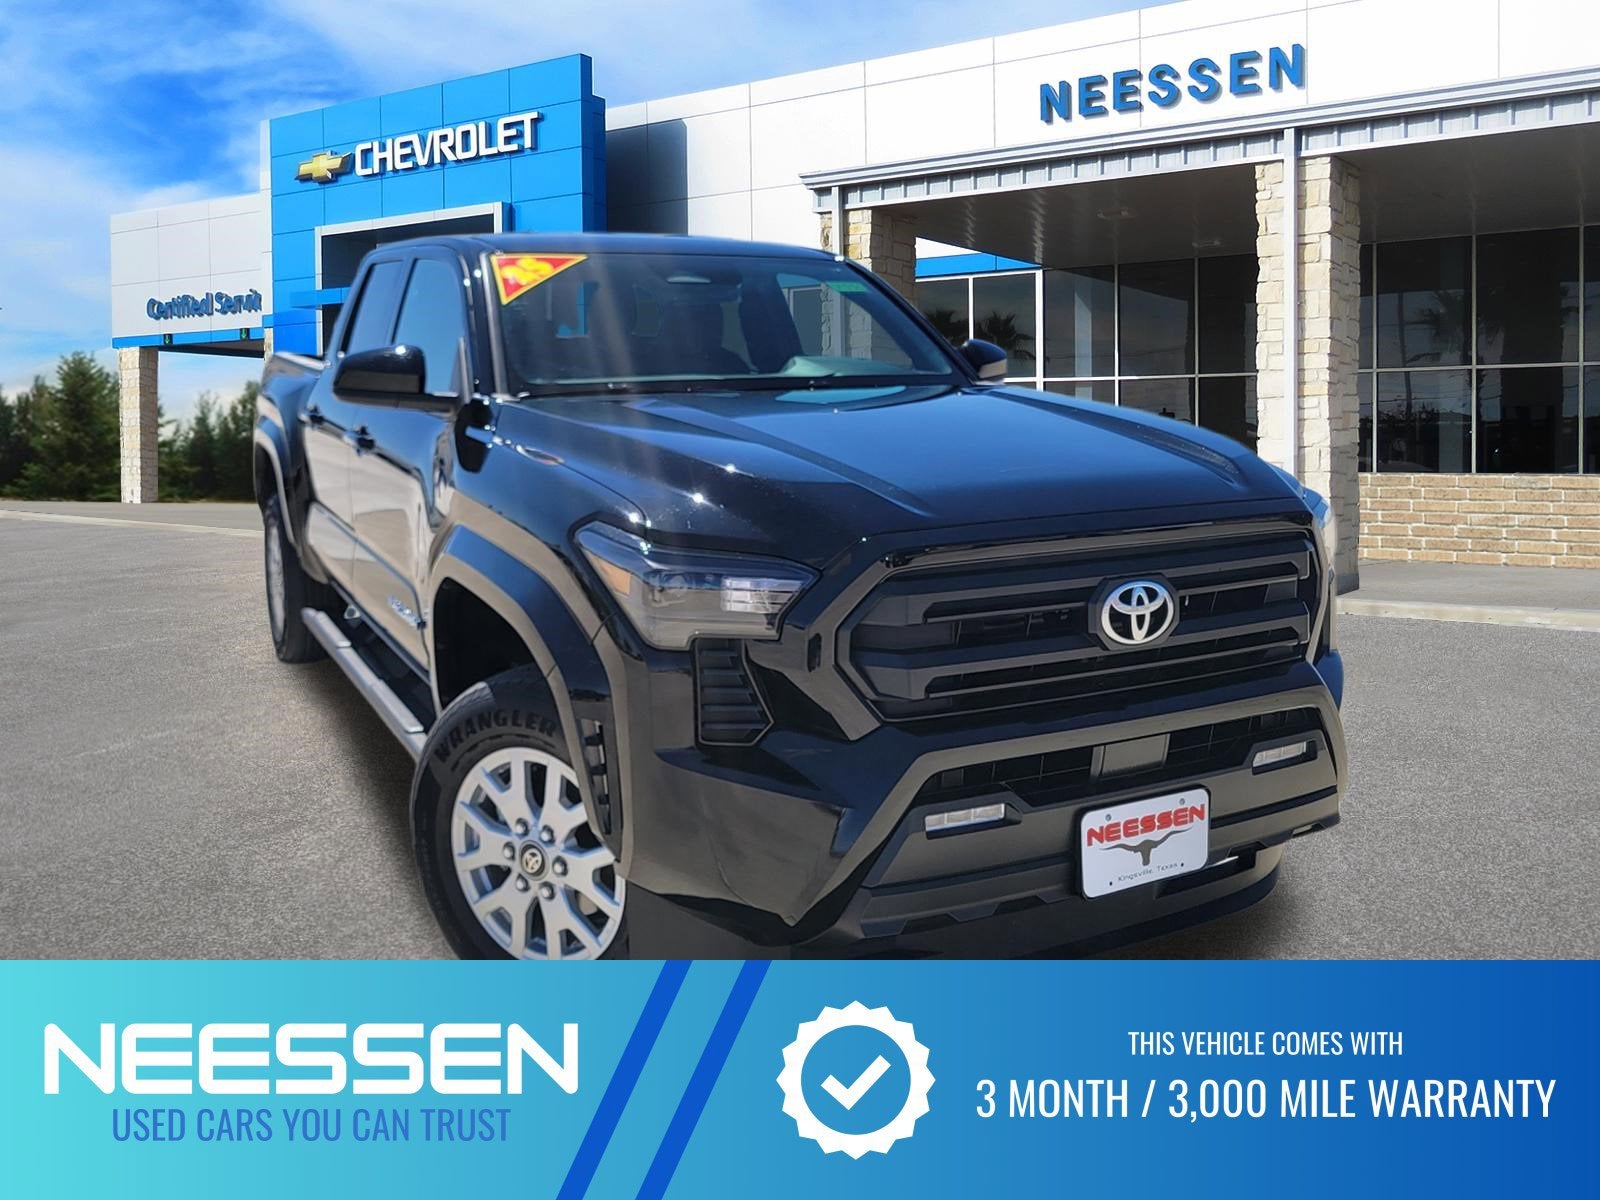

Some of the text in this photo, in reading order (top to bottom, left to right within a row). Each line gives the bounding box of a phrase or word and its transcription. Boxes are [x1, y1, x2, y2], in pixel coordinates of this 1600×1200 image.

[1040, 43, 1306, 124] NEESSEN
[354, 111, 543, 177] CHEVROLET
[146, 292, 214, 320] Certified
[433, 708, 557, 763] WRANGLER
[1086, 803, 1206, 847] NEESSEN
